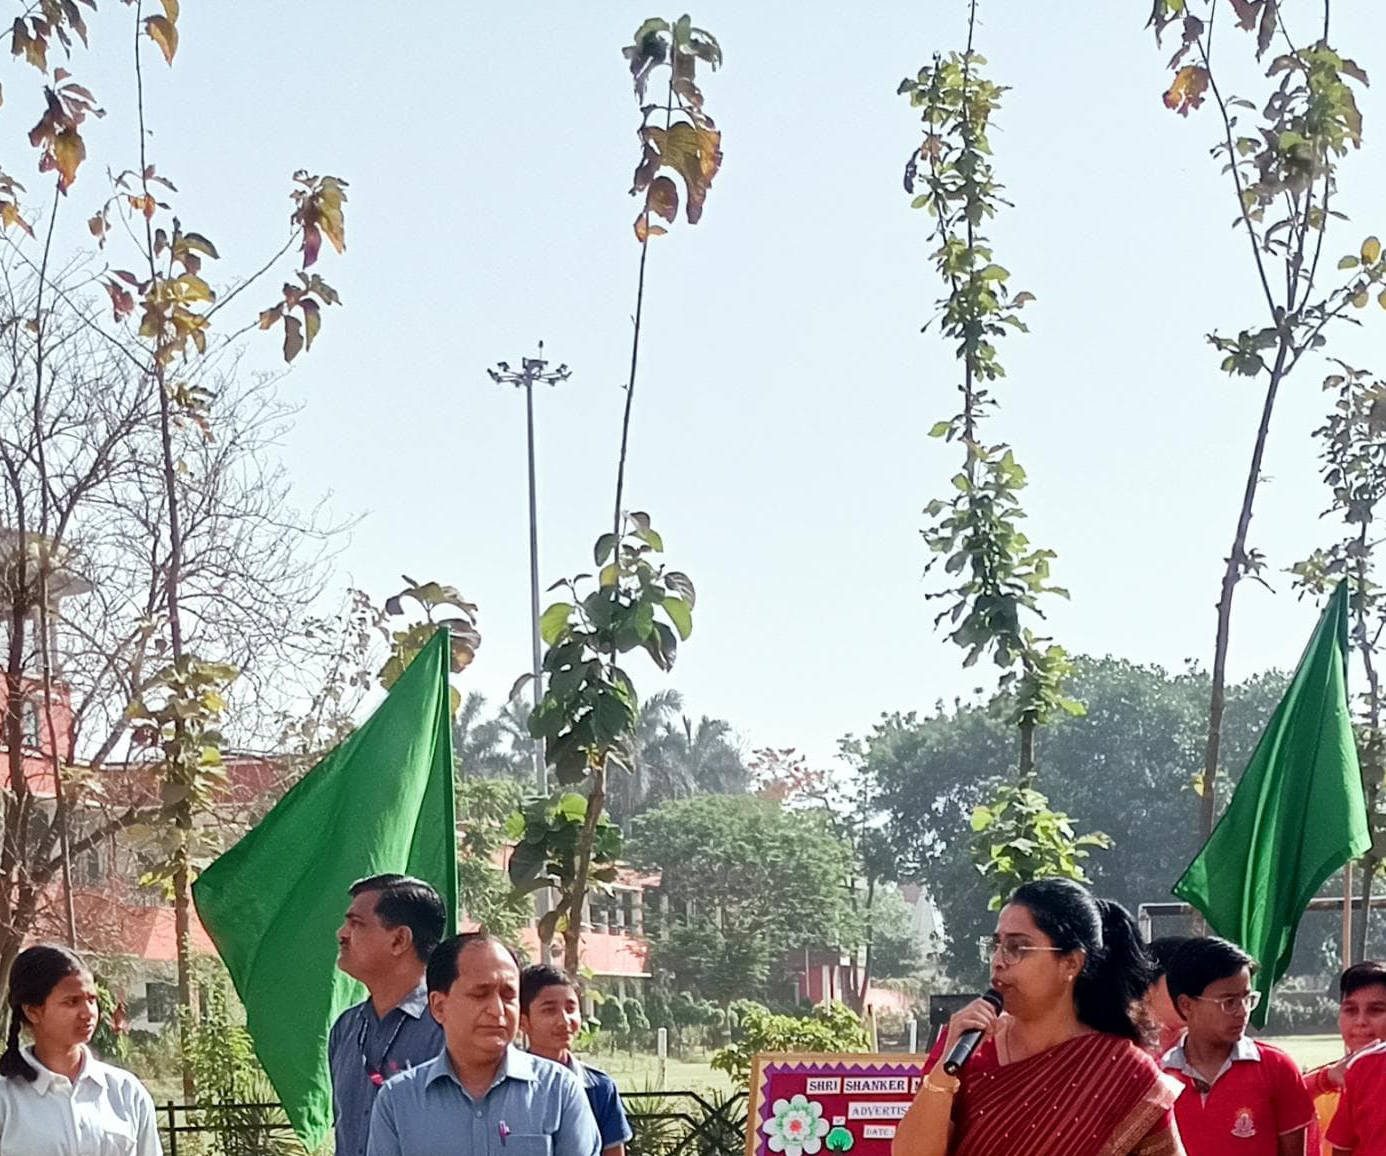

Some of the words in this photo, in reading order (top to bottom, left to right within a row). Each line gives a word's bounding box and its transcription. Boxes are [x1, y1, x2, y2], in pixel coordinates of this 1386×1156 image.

[809, 1080, 838, 1091] SHRI
[845, 1080, 905, 1091] SHANKER
[851, 1105, 911, 1116] ADVERTIS
